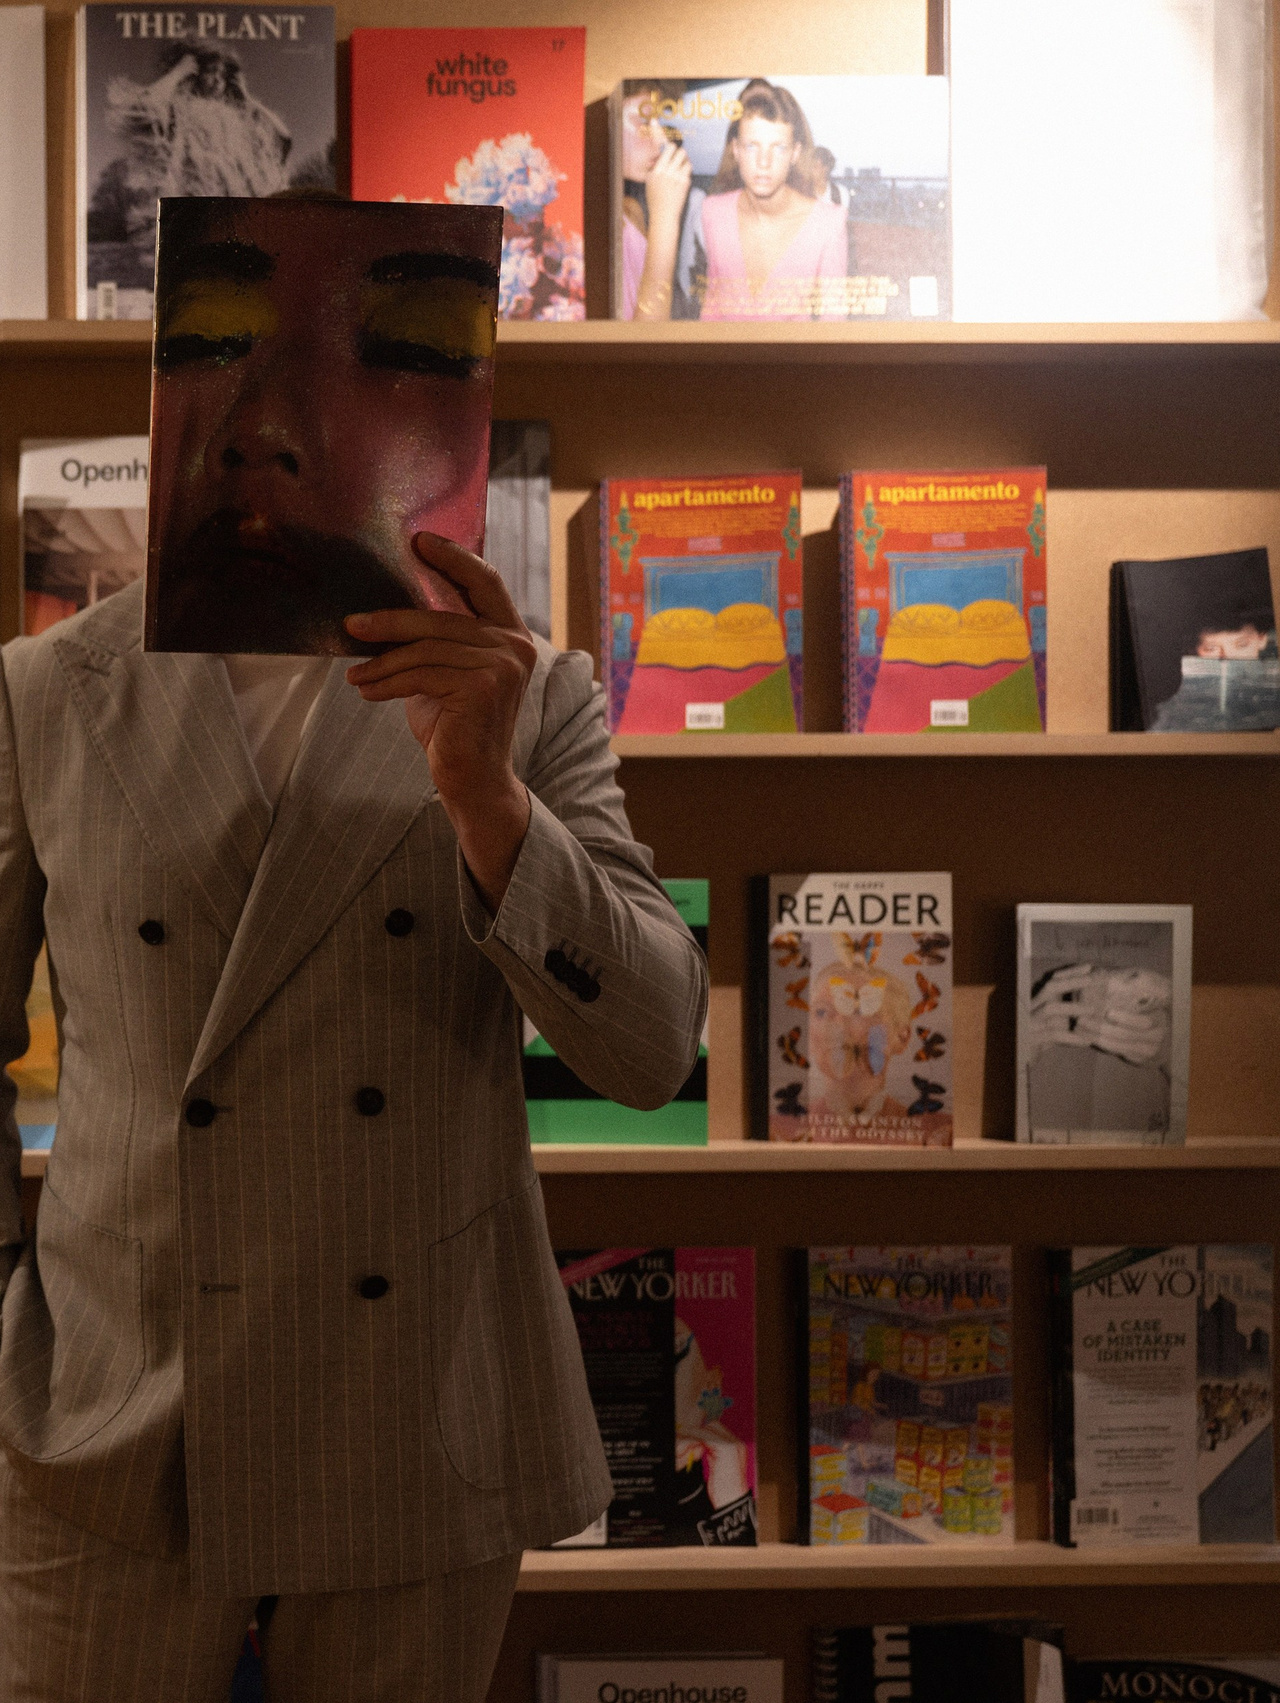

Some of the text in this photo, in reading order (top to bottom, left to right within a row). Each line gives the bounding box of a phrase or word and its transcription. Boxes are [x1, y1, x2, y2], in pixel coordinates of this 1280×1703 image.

[116, 12, 306, 40] THE PLANT
[435, 52, 508, 76] white
[426, 73, 517, 104] fungus
[638, 90, 745, 122] double
[633, 484, 776, 511] apartamento
[878, 481, 1020, 506] apartamento
[777, 893, 941, 926] READER
[638, 1257, 667, 1270] THE
[1159, 1256, 1188, 1268] THE
[630, 1270, 738, 1301] YORKER
[824, 1270, 993, 1299] NEW YORKER
[1086, 1270, 1148, 1299] NEW
[1106, 1319, 1162, 1333] A CASE
[1082, 1333, 1187, 1349] OF MISTAKEN
[1096, 1350, 1171, 1364] IDENTITY
